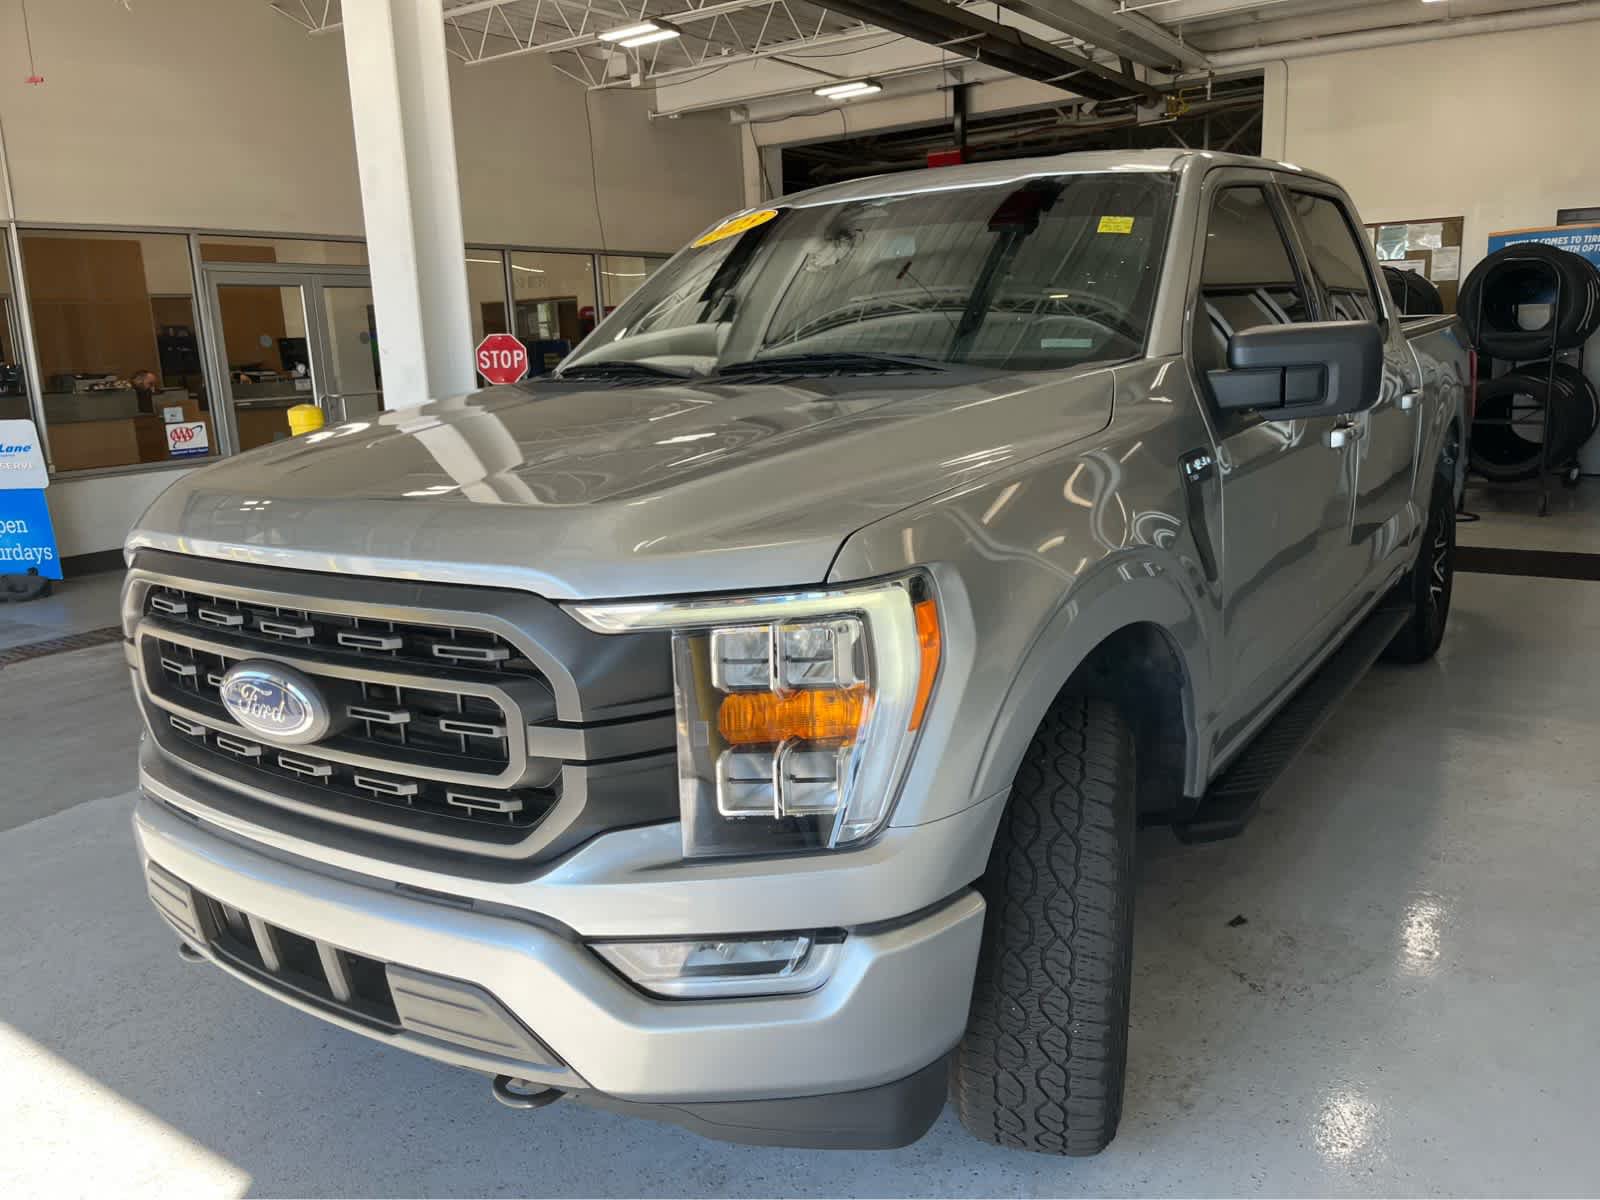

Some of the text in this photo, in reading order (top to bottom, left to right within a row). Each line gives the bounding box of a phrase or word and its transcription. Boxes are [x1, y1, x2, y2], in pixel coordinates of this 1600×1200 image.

[1571, 235, 1582, 244] TO
[480, 350, 524, 369] STOP
[0, 442, 32, 453] Lane
[240, 684, 286, 721] Ford
